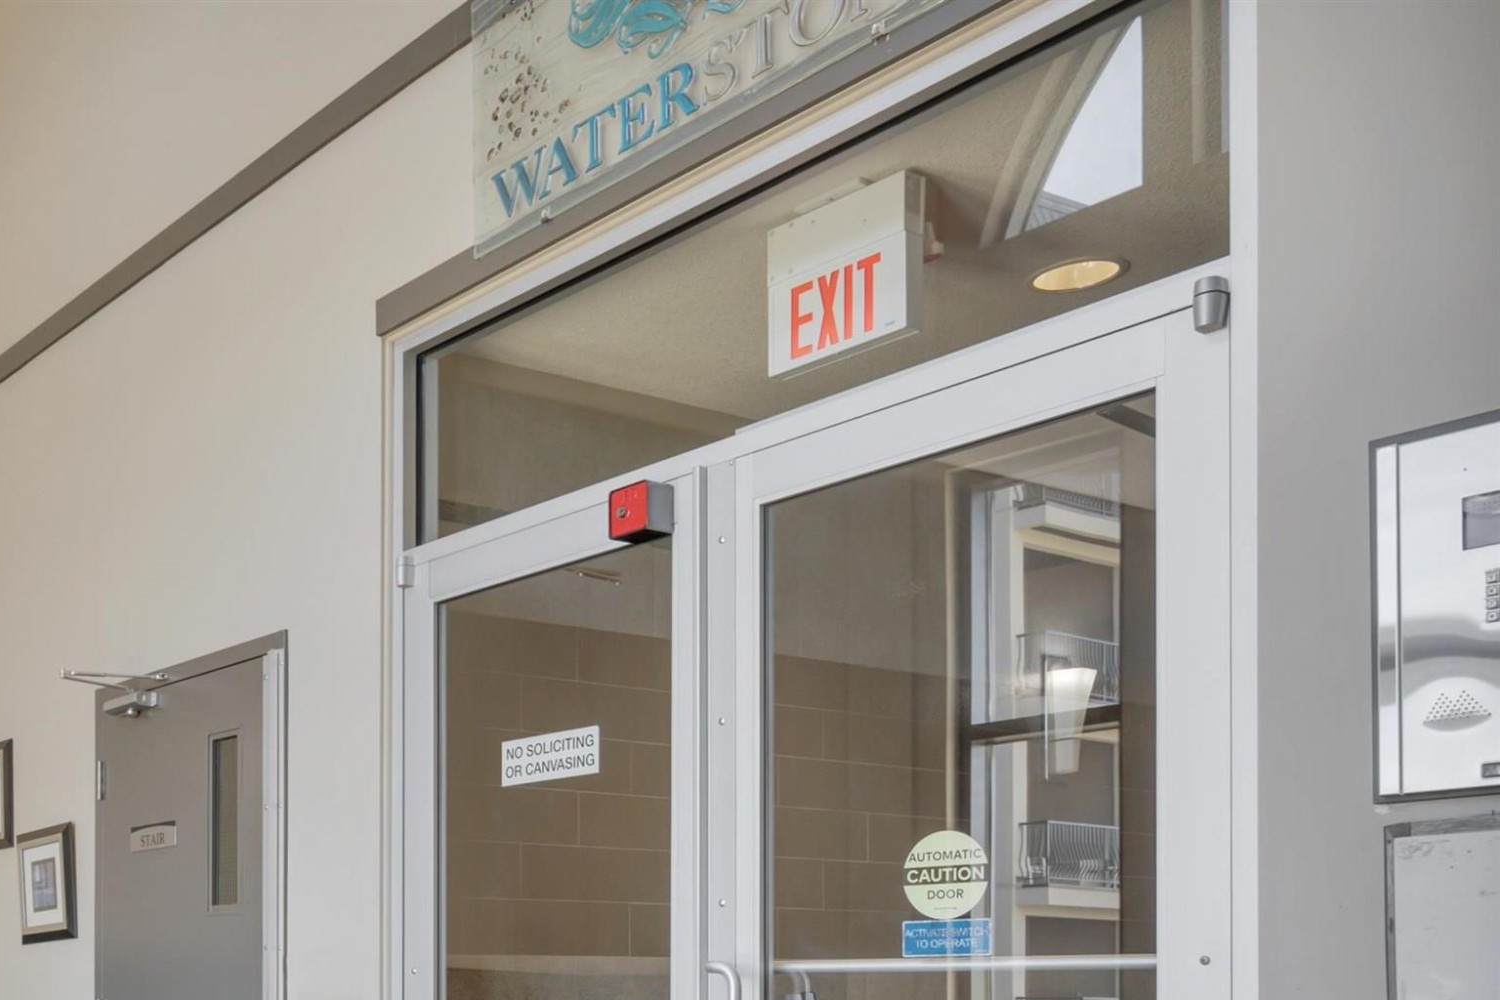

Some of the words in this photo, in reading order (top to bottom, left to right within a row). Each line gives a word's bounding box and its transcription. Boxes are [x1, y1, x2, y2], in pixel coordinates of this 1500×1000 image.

[490, 0, 871, 218] WATERSTO
[790, 252, 882, 361] EXIT
[506, 746, 524, 760] NO
[526, 734, 594, 757] SOLICITING
[505, 765, 522, 779] OR
[525, 753, 594, 775] CANVASING
[140, 832, 165, 848] STAIR
[909, 848, 981, 862] AUTOMATIC
[906, 865, 984, 883] CAUTION
[927, 889, 964, 899] DOOR
[916, 940, 928, 949] TO
